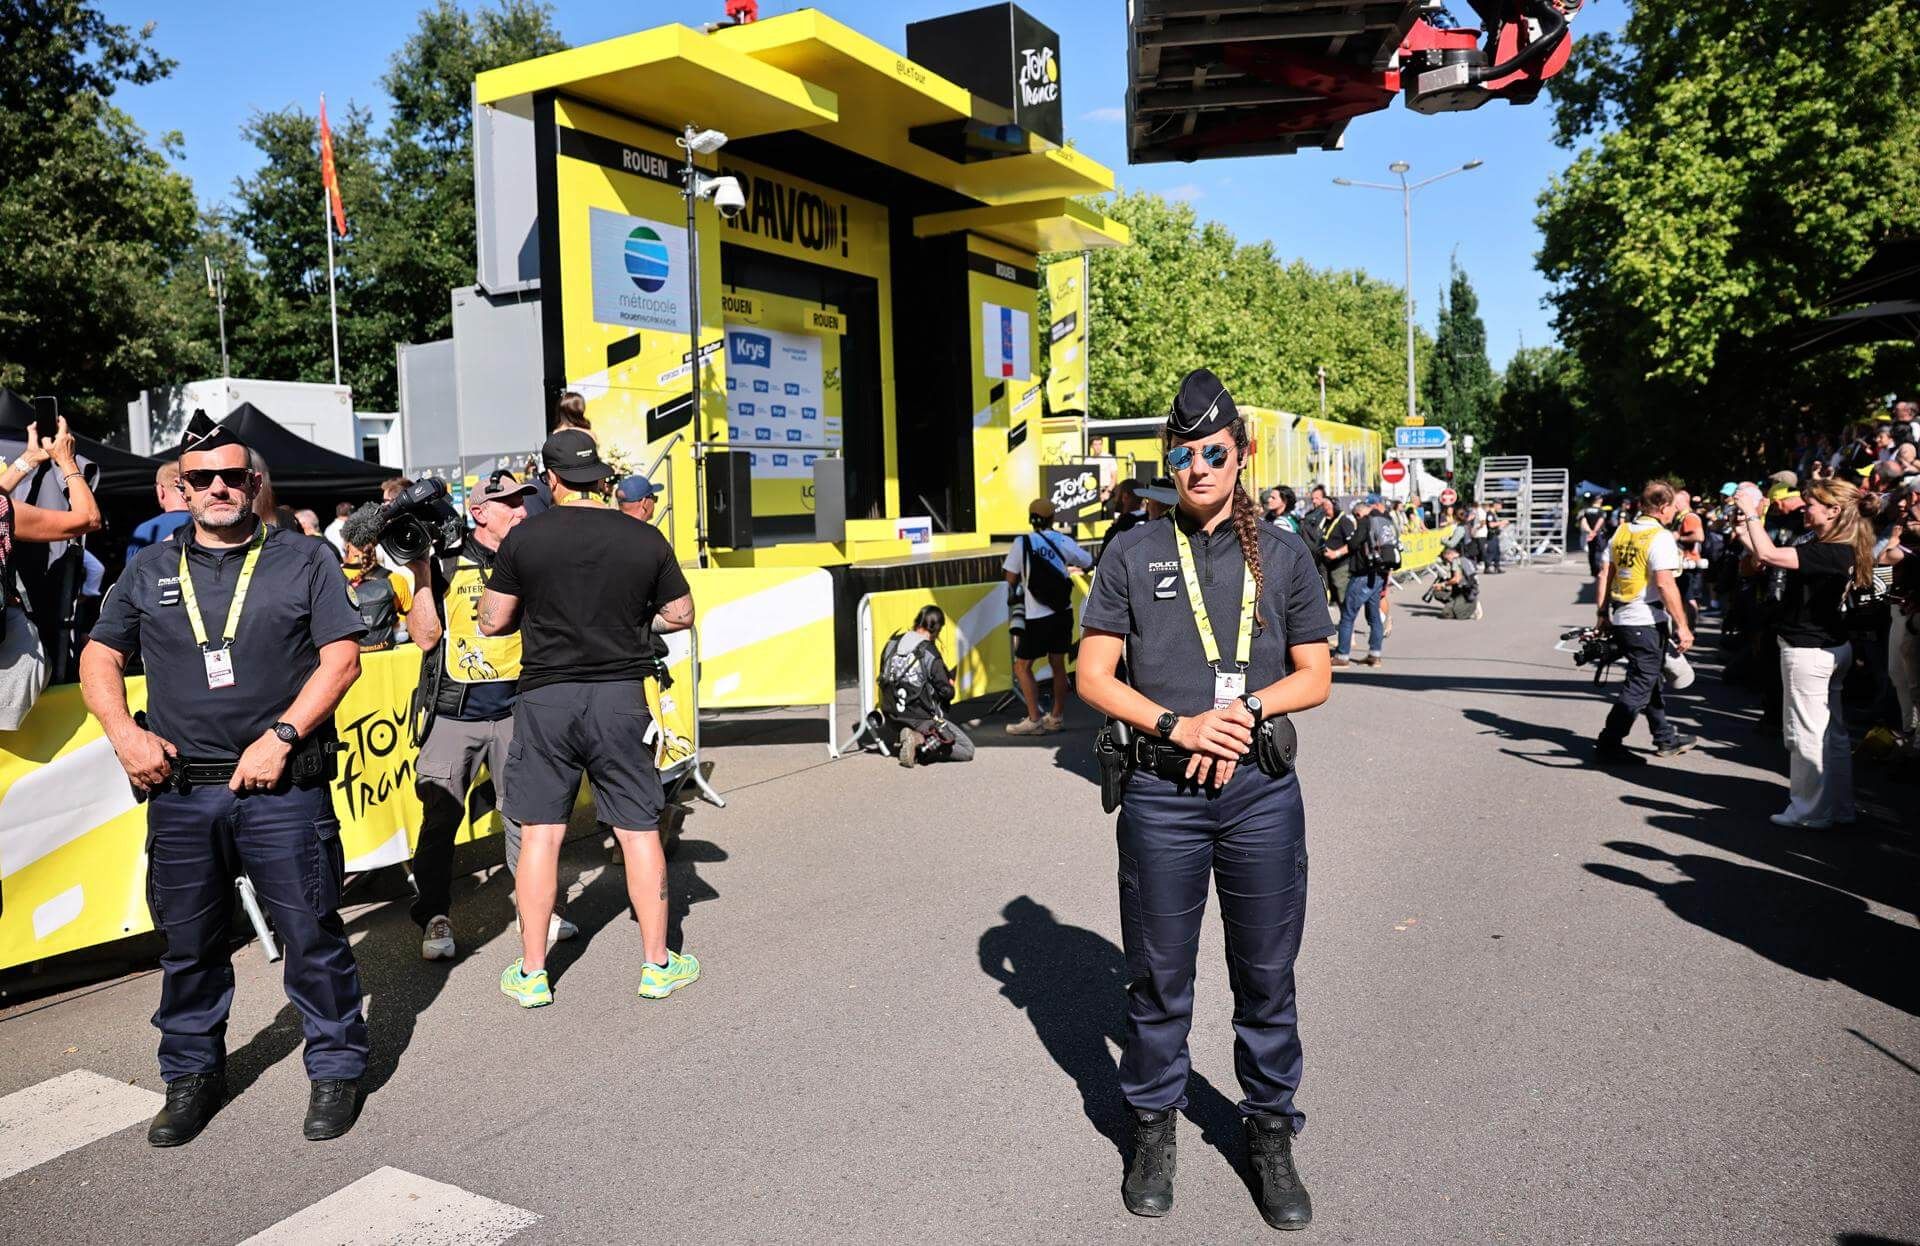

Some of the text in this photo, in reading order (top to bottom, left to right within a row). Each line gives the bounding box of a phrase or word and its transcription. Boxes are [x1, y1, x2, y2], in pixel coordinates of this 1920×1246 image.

[623, 148, 668, 178] ROUEN
[619, 293, 677, 314] métropole
[721, 295, 752, 315] ROUEN
[813, 312, 839, 331] ROUEN
[736, 337, 766, 360] Krys
[457, 586, 485, 595] INTER
